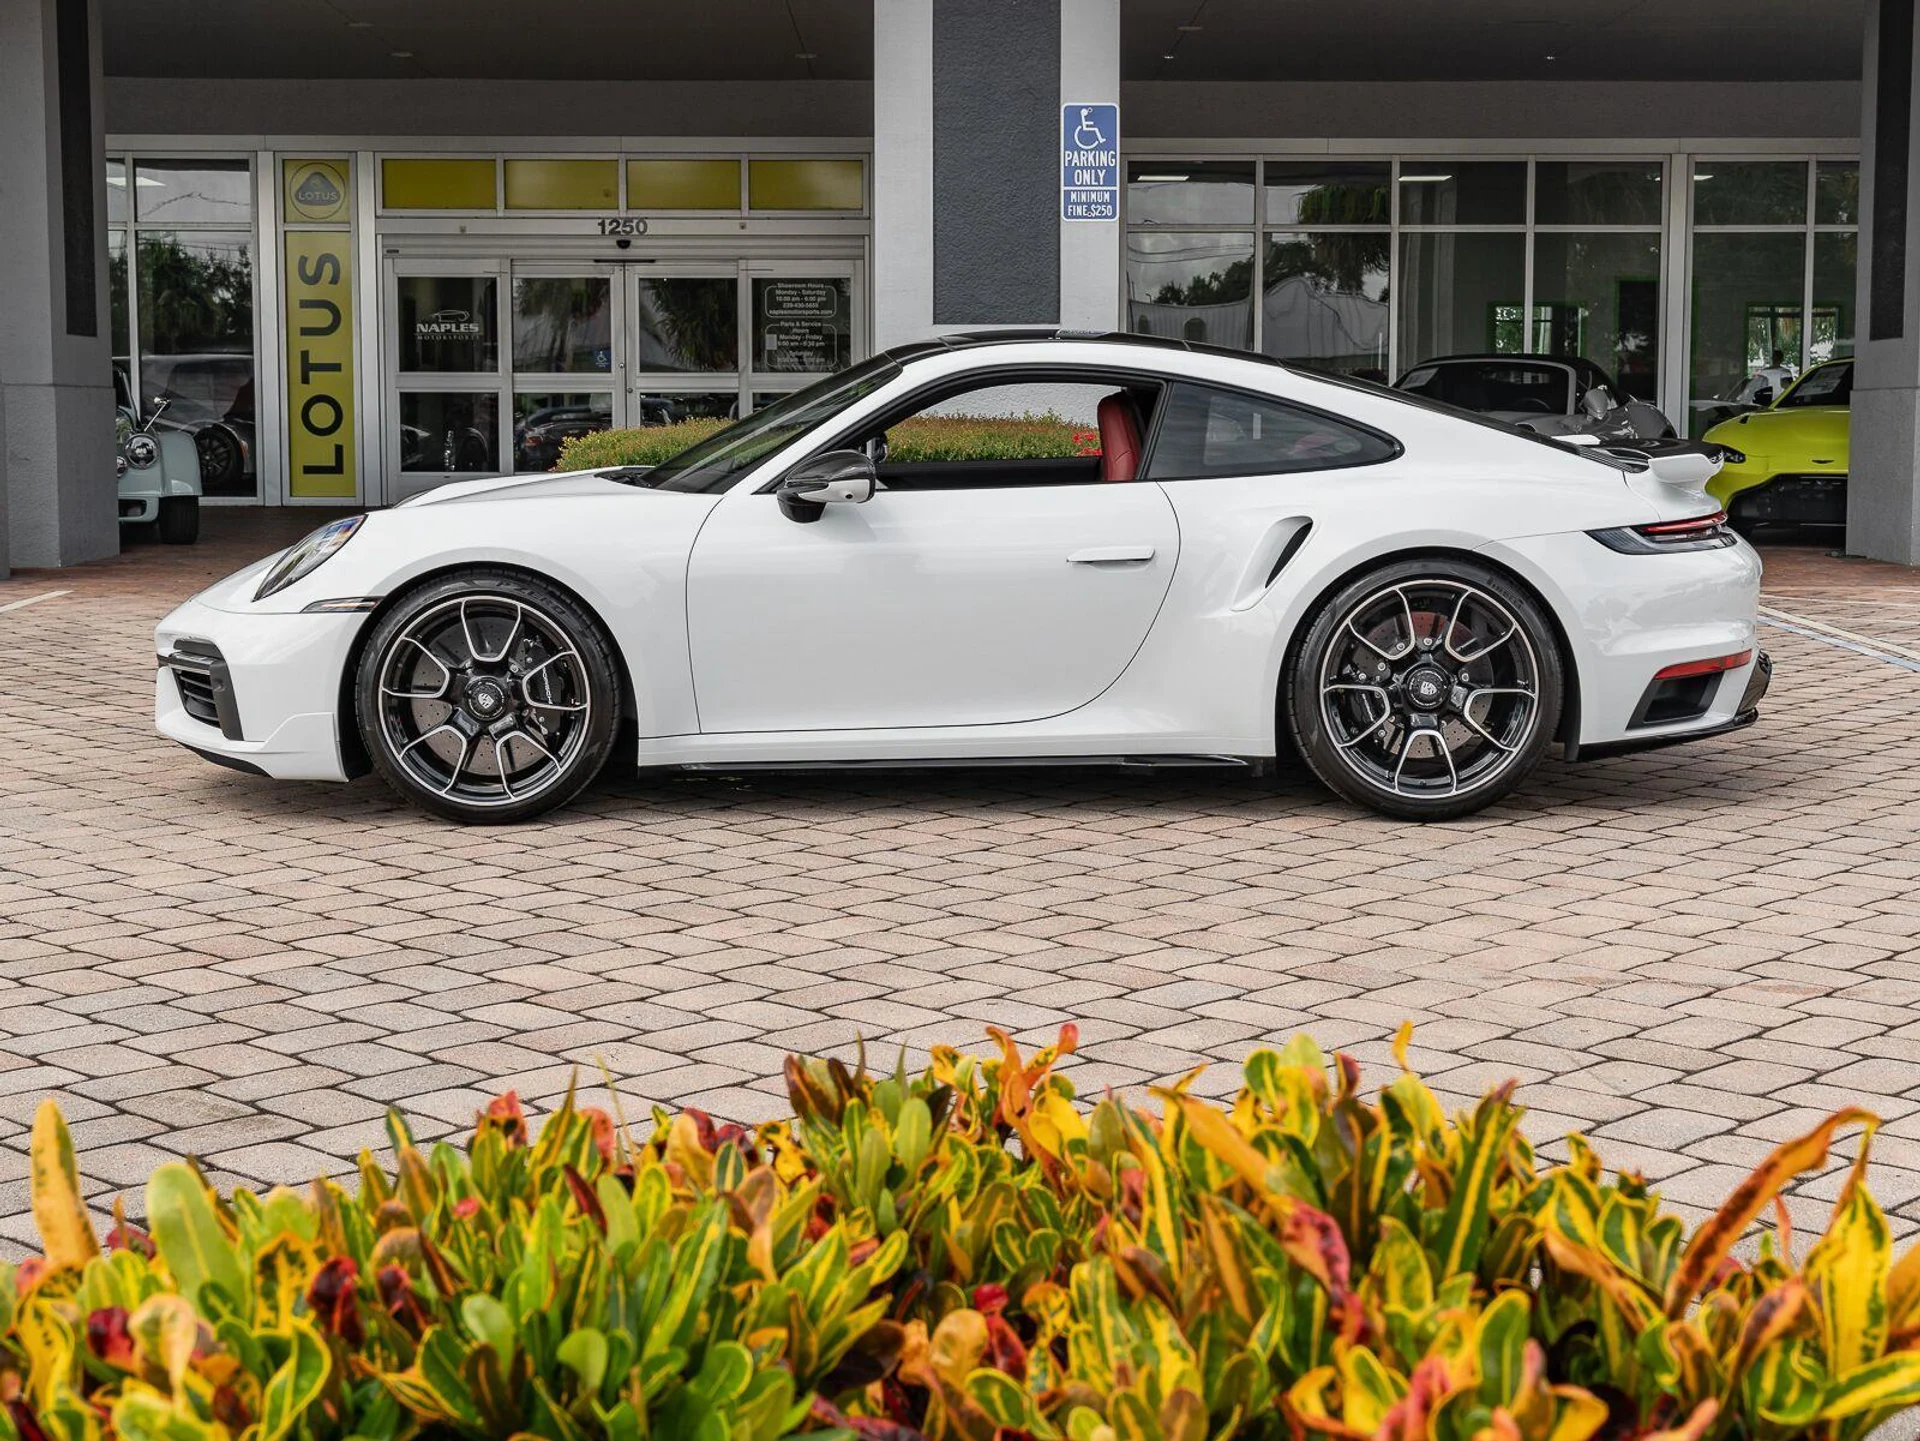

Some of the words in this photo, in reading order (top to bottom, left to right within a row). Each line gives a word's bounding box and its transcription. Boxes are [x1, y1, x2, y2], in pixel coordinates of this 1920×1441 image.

[1064, 150, 1116, 167] PARKING
[1074, 169, 1106, 186] ONLY
[298, 191, 338, 201] LOTUS
[1070, 191, 1110, 203] MINIMUM
[1067, 205, 1088, 216] FINE
[1091, 204, 1113, 217] $250
[597, 218, 648, 236] 1250
[416, 323, 480, 333] NAPLES
[297, 252, 344, 475] LOTUS
